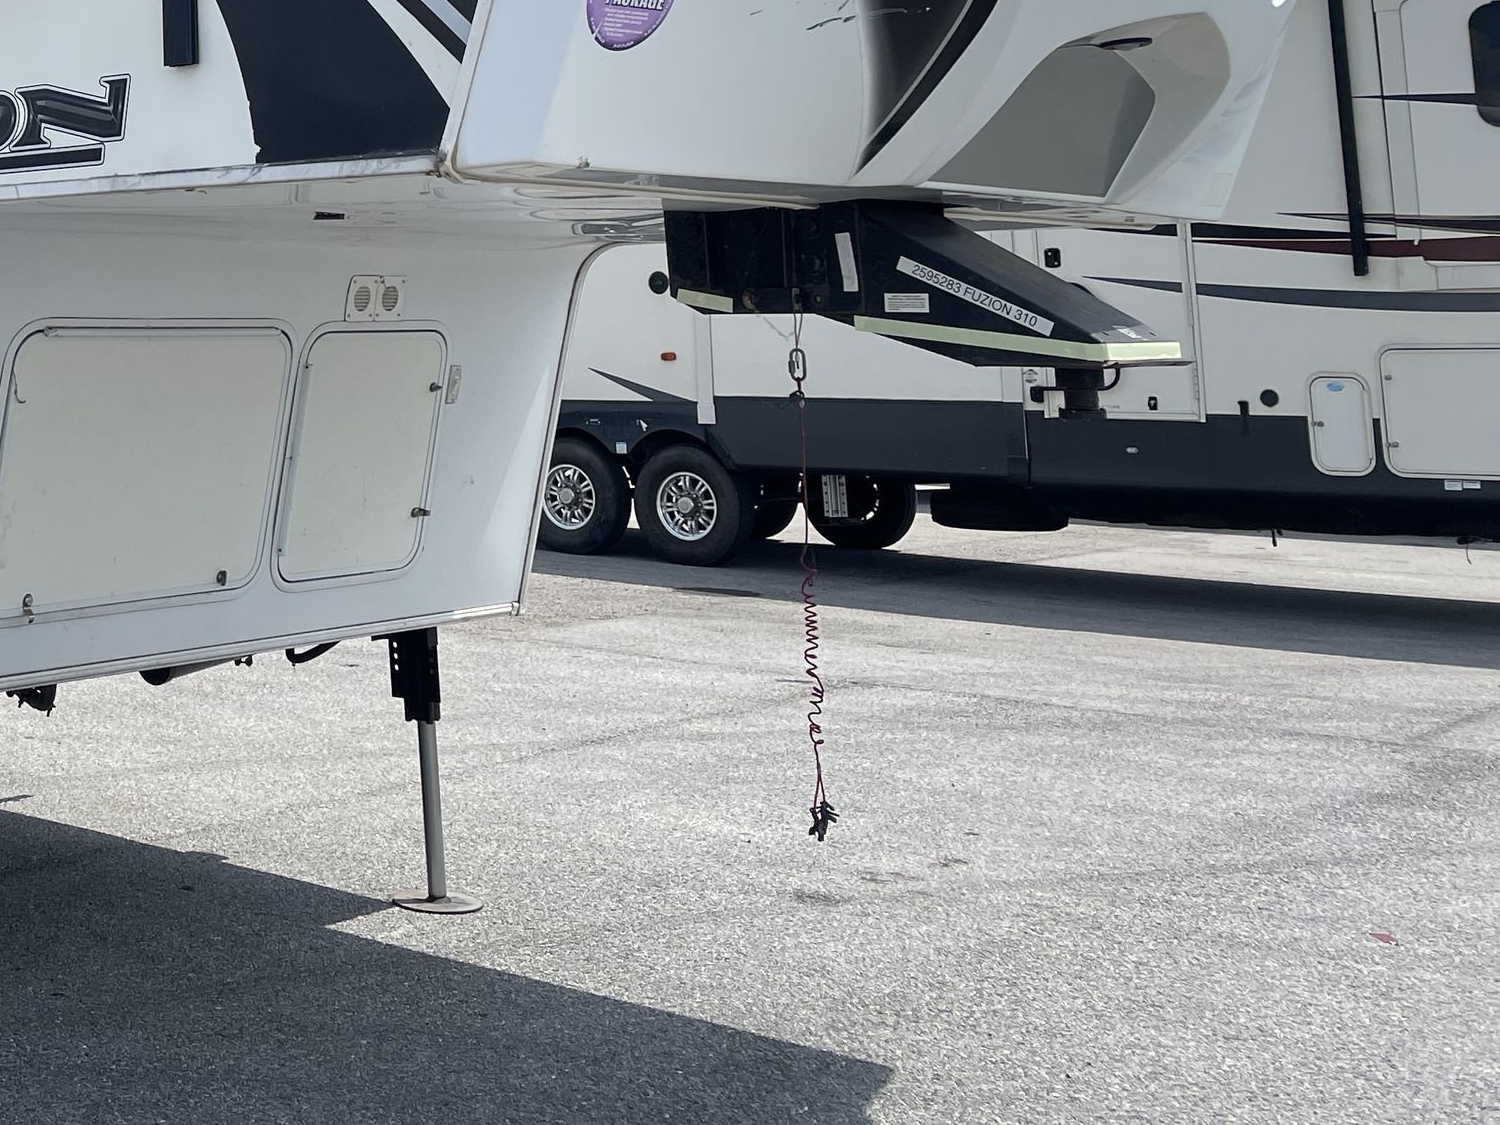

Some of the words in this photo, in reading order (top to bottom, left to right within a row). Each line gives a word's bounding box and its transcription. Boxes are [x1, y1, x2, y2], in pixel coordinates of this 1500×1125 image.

[911, 264, 962, 294] 2595283
[964, 286, 1013, 316] FUZION
[1014, 309, 1038, 327] 310
